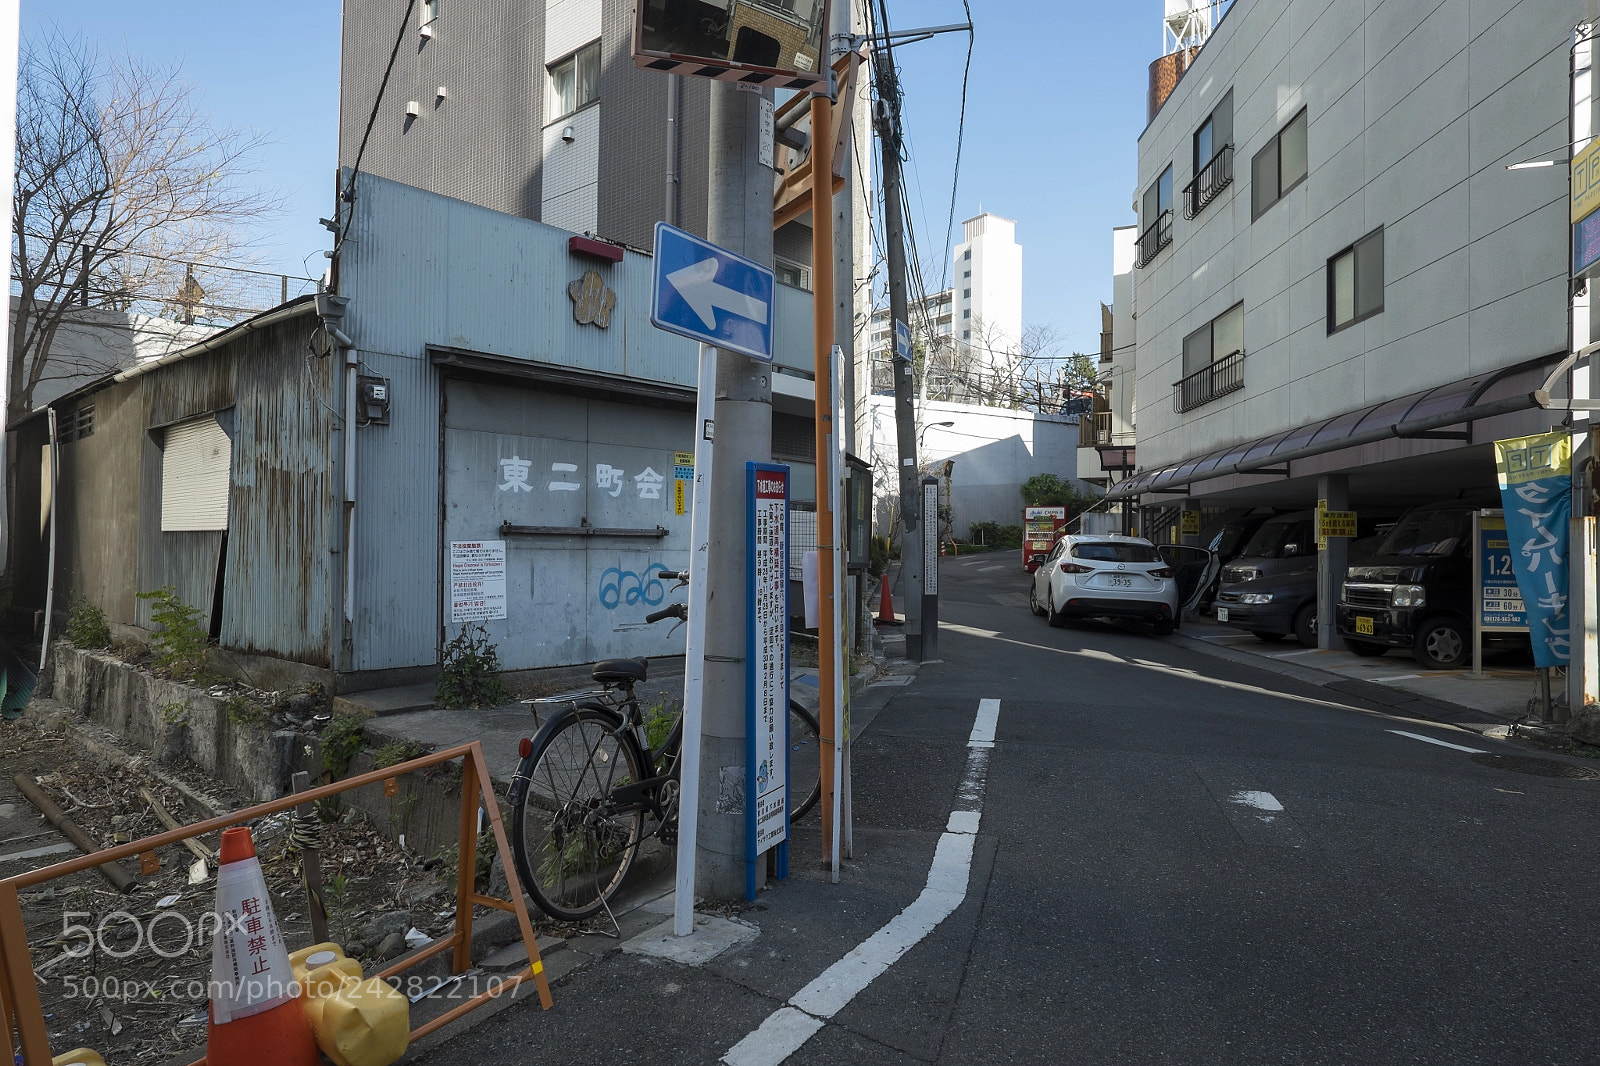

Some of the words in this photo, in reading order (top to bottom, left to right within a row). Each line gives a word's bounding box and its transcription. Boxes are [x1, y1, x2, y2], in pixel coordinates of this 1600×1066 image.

[1577, 168, 1584, 189] T
[499, 456, 665, 499] 東二町会
[241, 896, 271, 976] 駐車禁止
